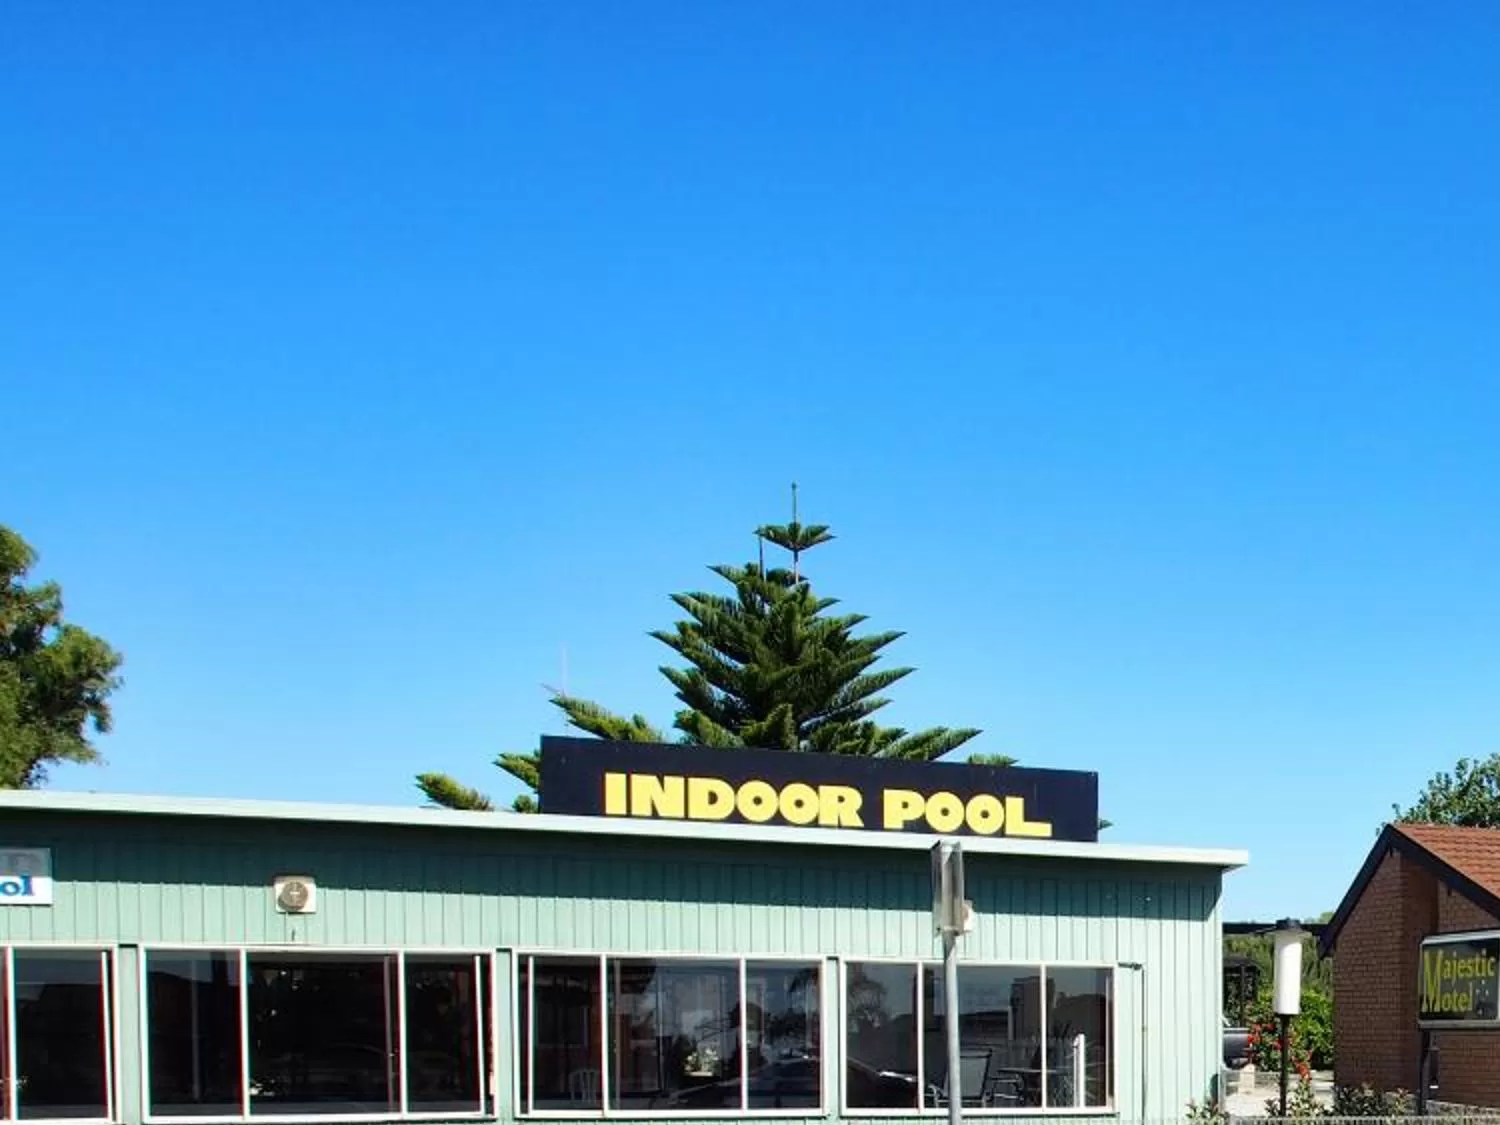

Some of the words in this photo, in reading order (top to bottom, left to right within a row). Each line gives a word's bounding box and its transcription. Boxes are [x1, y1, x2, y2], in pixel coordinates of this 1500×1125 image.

[604, 772, 865, 828] INDOOR
[883, 788, 1053, 838] POOL
[1421, 947, 1497, 988] Majestic
[1421, 978, 1474, 1013] Motel
